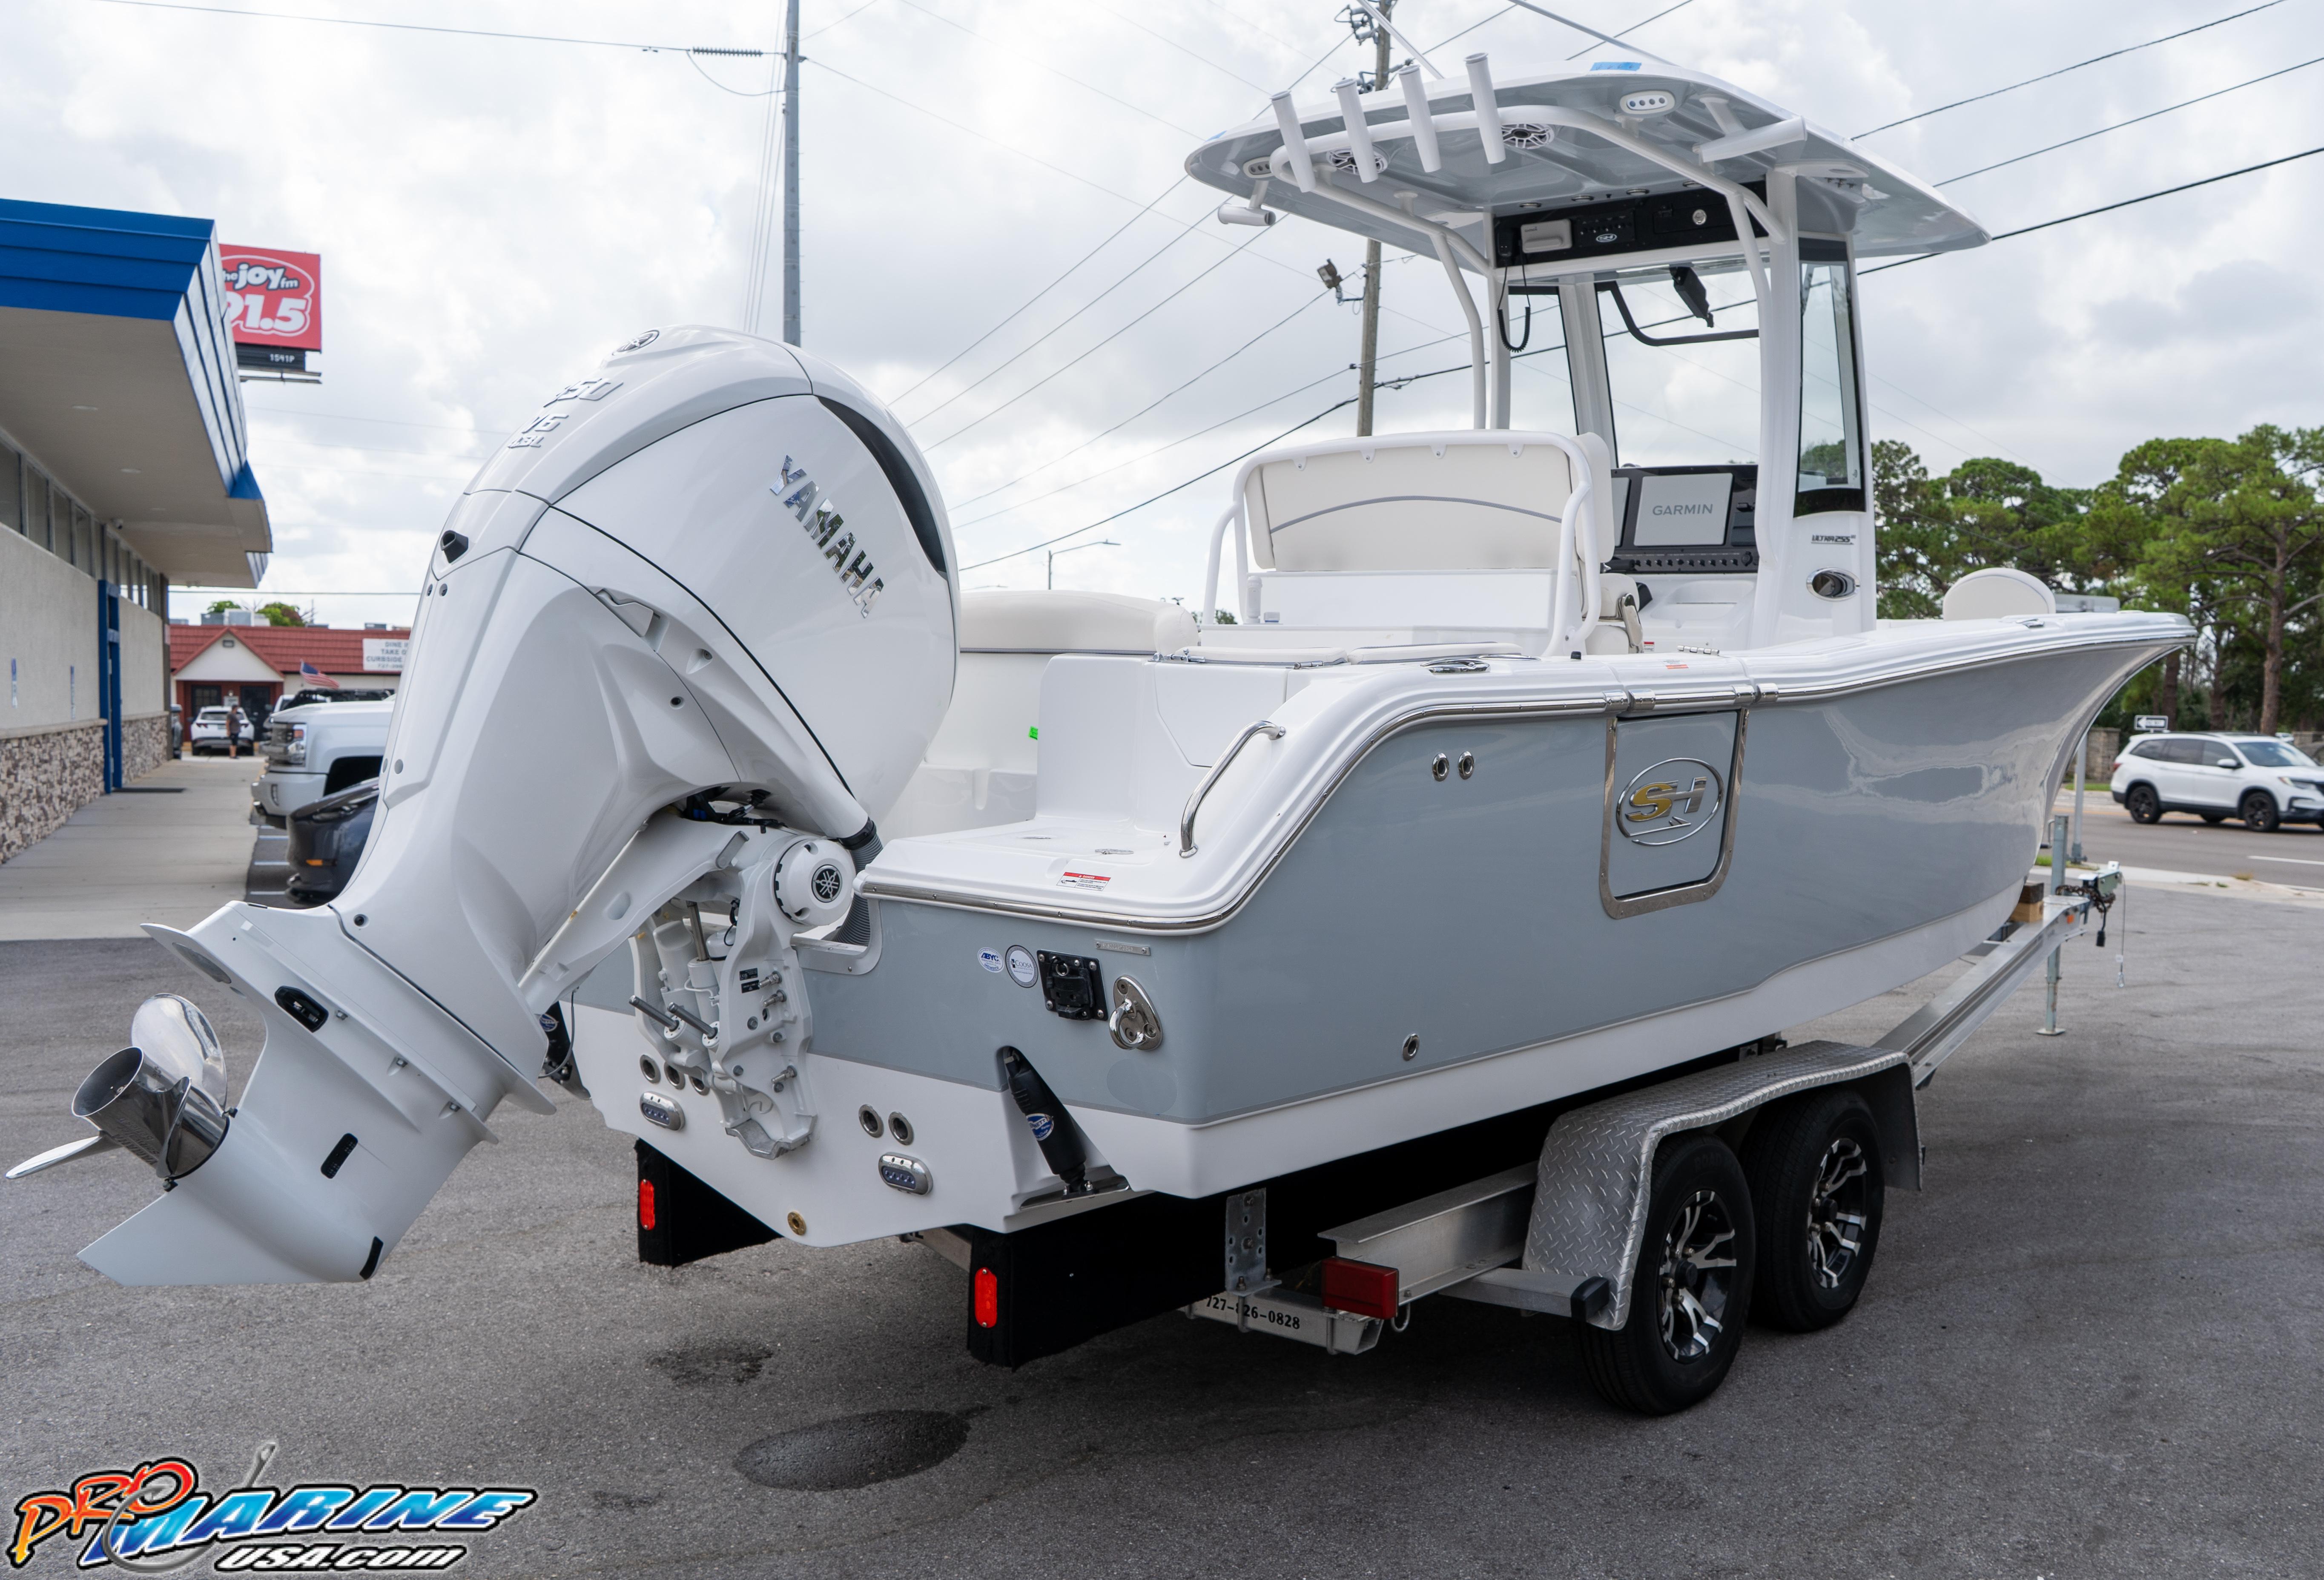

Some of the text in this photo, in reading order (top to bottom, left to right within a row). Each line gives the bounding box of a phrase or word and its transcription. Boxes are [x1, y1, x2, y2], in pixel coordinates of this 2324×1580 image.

[1653, 503, 1713, 516] GARMIN
[770, 454, 884, 618] YAMAHA
[981, 953, 999, 962] ABYC
[1015, 960, 1033, 968] COOSA
